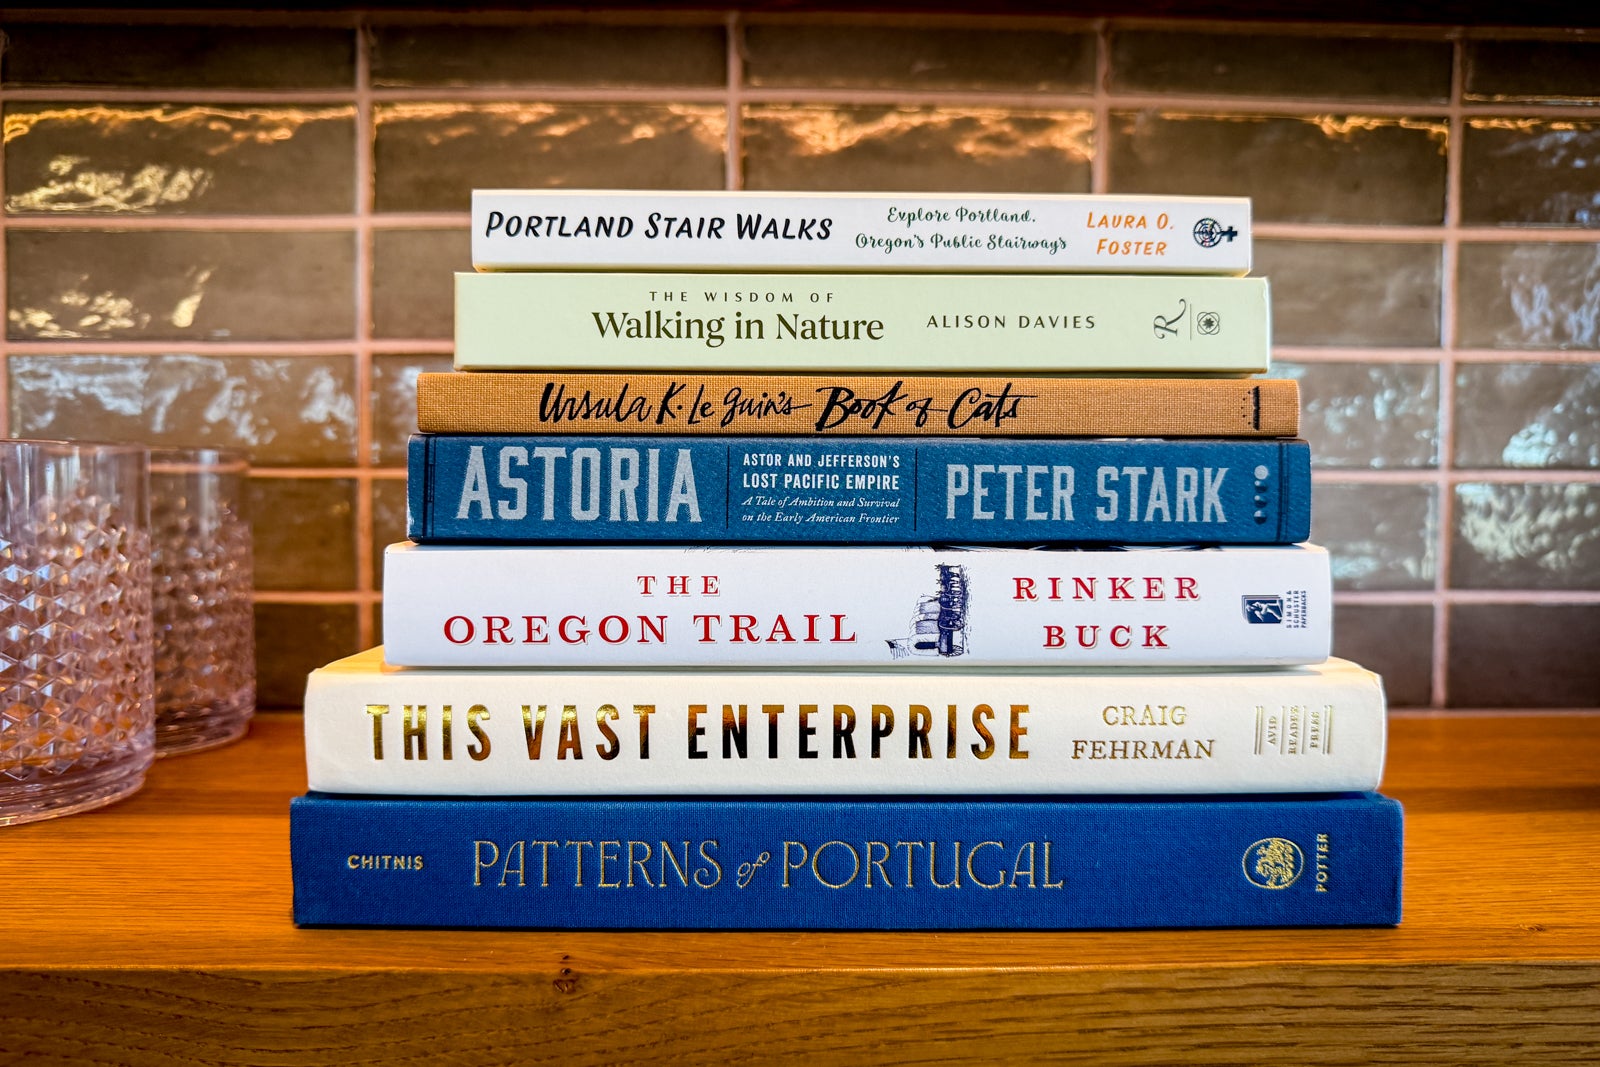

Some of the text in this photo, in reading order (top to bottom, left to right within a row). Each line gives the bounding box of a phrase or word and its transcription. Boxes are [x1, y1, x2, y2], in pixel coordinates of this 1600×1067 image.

[485, 211, 833, 241] PORTLAND STAIR WALKS
[887, 206, 951, 228] Explore
[1086, 211, 1174, 230] LAURA O.
[930, 233, 983, 249] Public
[986, 234, 1067, 255] Stairways
[1096, 238, 1167, 256] FOSTER
[649, 291, 834, 303] THE WISDOM OF
[591, 309, 884, 349] Walking in Nature
[926, 314, 1096, 330] ALISON DAVIES
[539, 382, 652, 423] Ursula
[687, 384, 715, 425] Le
[815, 380, 909, 432] Book
[905, 397, 949, 428] of
[947, 382, 1038, 430] Cats
[743, 453, 900, 469] ASTOR AND JEFFERSON'S
[455, 445, 703, 523] ASTORIA
[743, 473, 900, 490] LOST PACIFIC EMPIRE
[741, 496, 901, 509] A Tale of Ambition and Survival
[945, 463, 1230, 524] PETER STARK
[741, 511, 900, 525] on the Early American Frontier
[636, 575, 721, 596] THE
[1012, 577, 1200, 601] RINKER
[443, 613, 858, 645] OREGON TRAIL
[1042, 625, 1169, 650] BUCK
[1102, 704, 1187, 727] CRAIG
[366, 703, 1030, 762] THIS VAST ENTERPRISE
[1267, 715, 1277, 745] AVID
[1071, 739, 1216, 760] FEHRMAN
[347, 854, 424, 871] CHITNIS
[473, 840, 1064, 889] PATTERNS of PORTUGAL
[1315, 833, 1329, 893] POTTER
